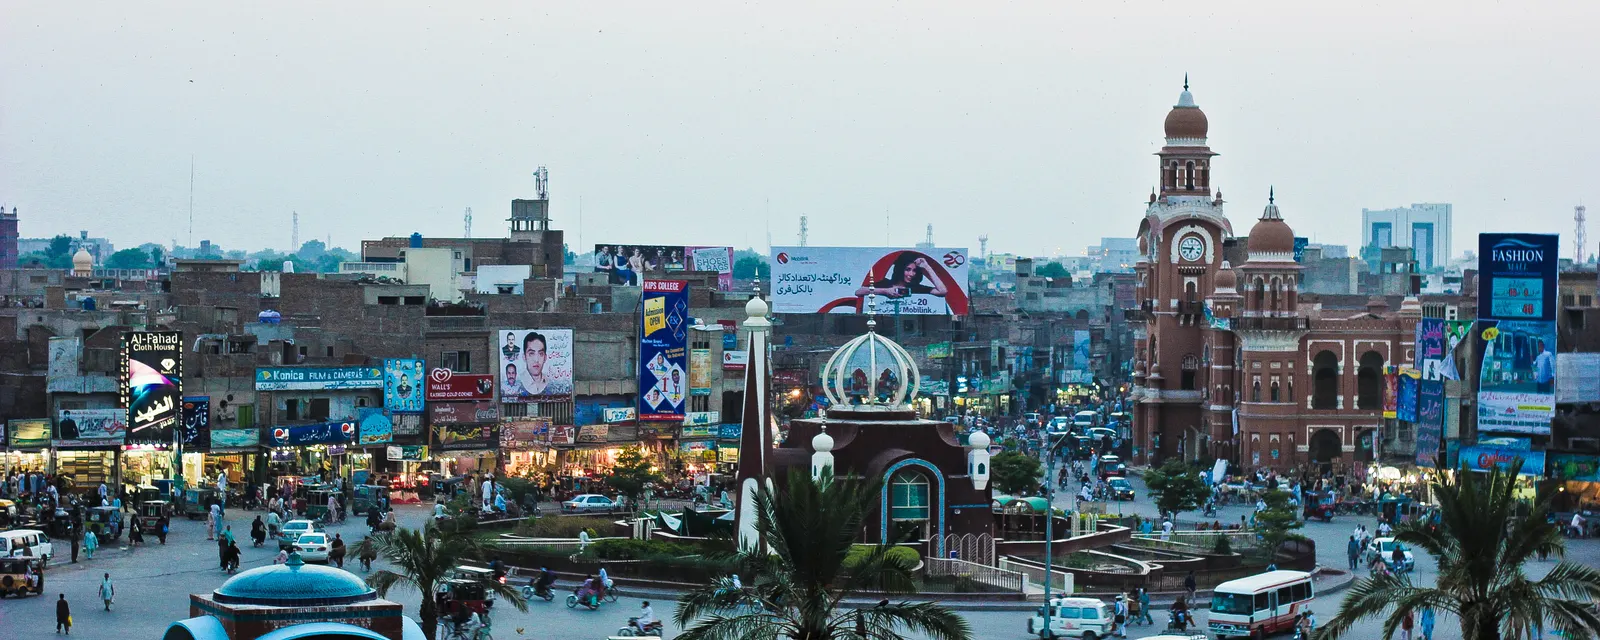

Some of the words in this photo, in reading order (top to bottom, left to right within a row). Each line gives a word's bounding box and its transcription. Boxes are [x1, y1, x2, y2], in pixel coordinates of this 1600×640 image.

[1492, 250, 1544, 262] FASHION
[697, 257, 726, 266] SHOES
[1507, 263, 1528, 271] MALL
[644, 282, 656, 290] KIPS
[658, 282, 679, 291] COLLEGE
[650, 316, 660, 326] OPEN
[130, 333, 178, 344] Al-Fahad
[133, 343, 152, 351] Cloth
[274, 370, 304, 380] Konica
[334, 370, 362, 380] CAMERAS
